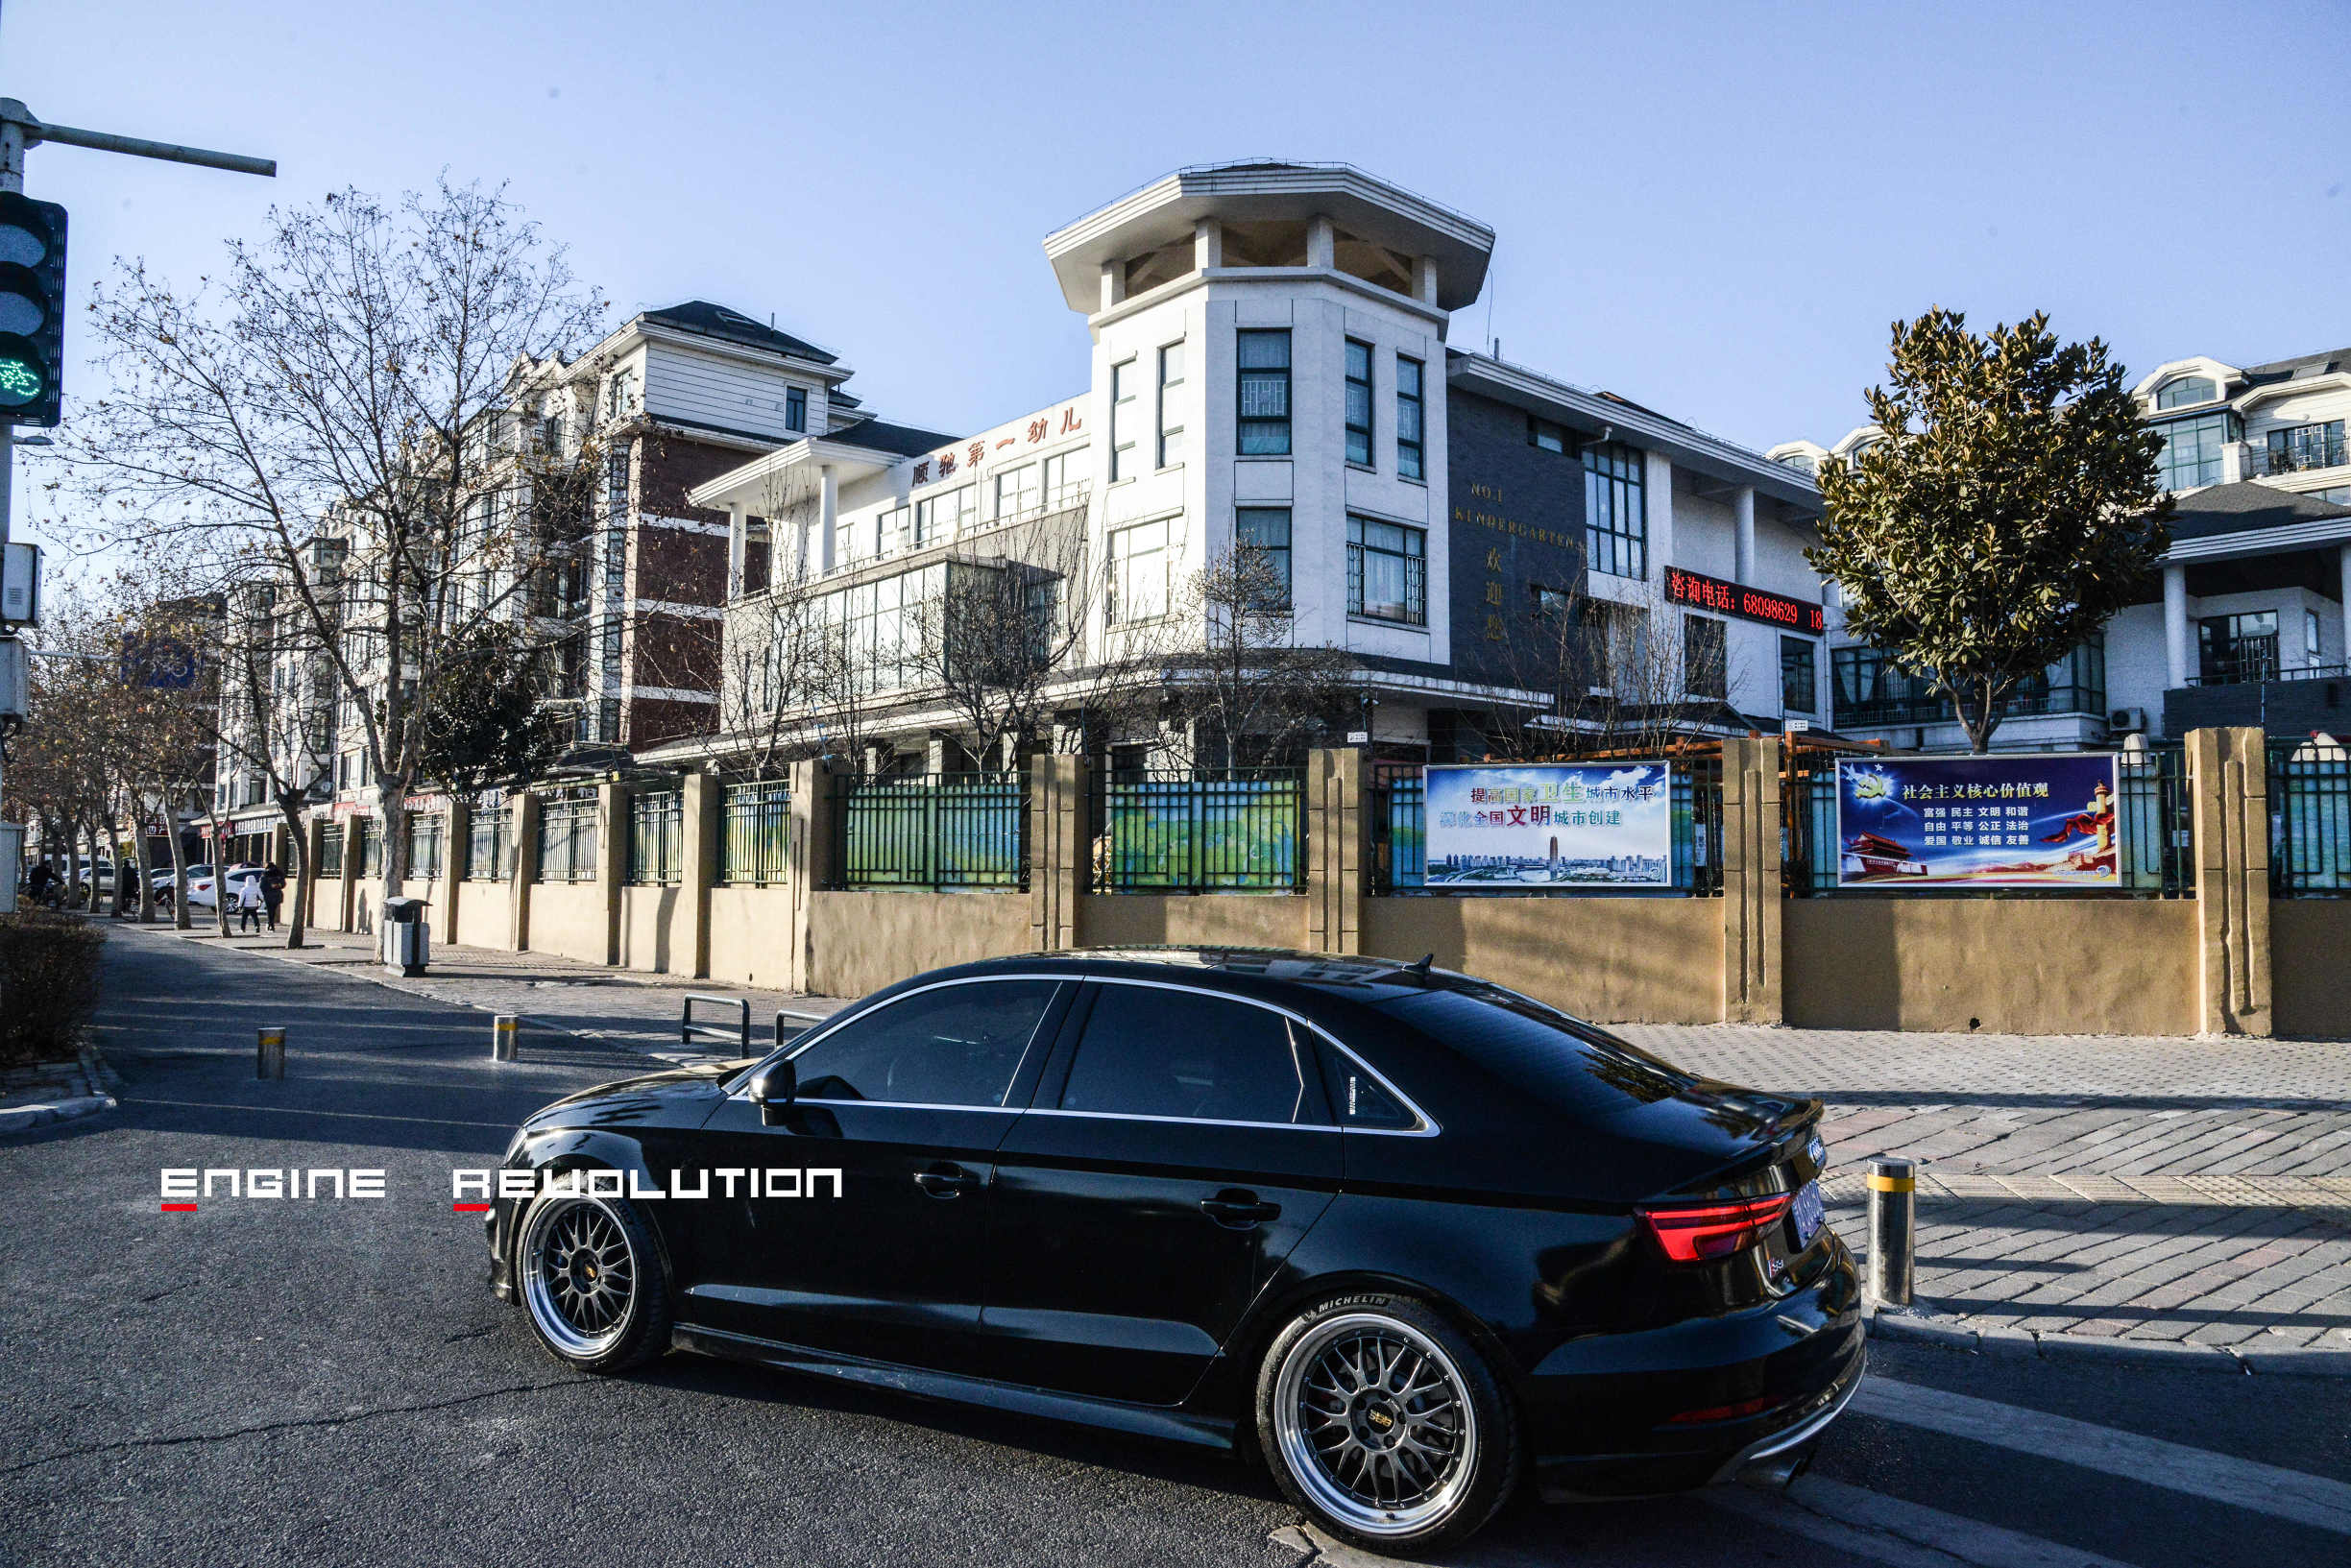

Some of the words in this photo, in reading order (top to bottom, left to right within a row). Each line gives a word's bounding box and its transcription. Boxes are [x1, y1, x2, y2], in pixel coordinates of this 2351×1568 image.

[912, 406, 1082, 488] 顺驰第一幼儿
[1454, 506, 1574, 547] KINDERGARTEN
[1743, 592, 1798, 624] 68098629
[1809, 610, 1823, 630] 18
[1470, 783, 1654, 804] 提高国家卫生城市水平
[1902, 783, 2049, 800] 社会主义核心价值观
[1923, 806, 1946, 818] 富强
[1951, 806, 1974, 818] 民主
[1978, 806, 2000, 818] 文明
[2005, 806, 2029, 818] 和谐
[1923, 820, 1946, 832] 自由
[1951, 820, 1974, 832] 平等
[1978, 820, 2000, 832] 公正
[2005, 820, 2029, 832] 法治
[1923, 834, 1946, 846] 爱国
[1951, 834, 1974, 846] 敬业
[1978, 834, 2000, 846] 诚信
[2005, 834, 2029, 846] 友善
[1319, 1295, 1387, 1313] MICHELIN
